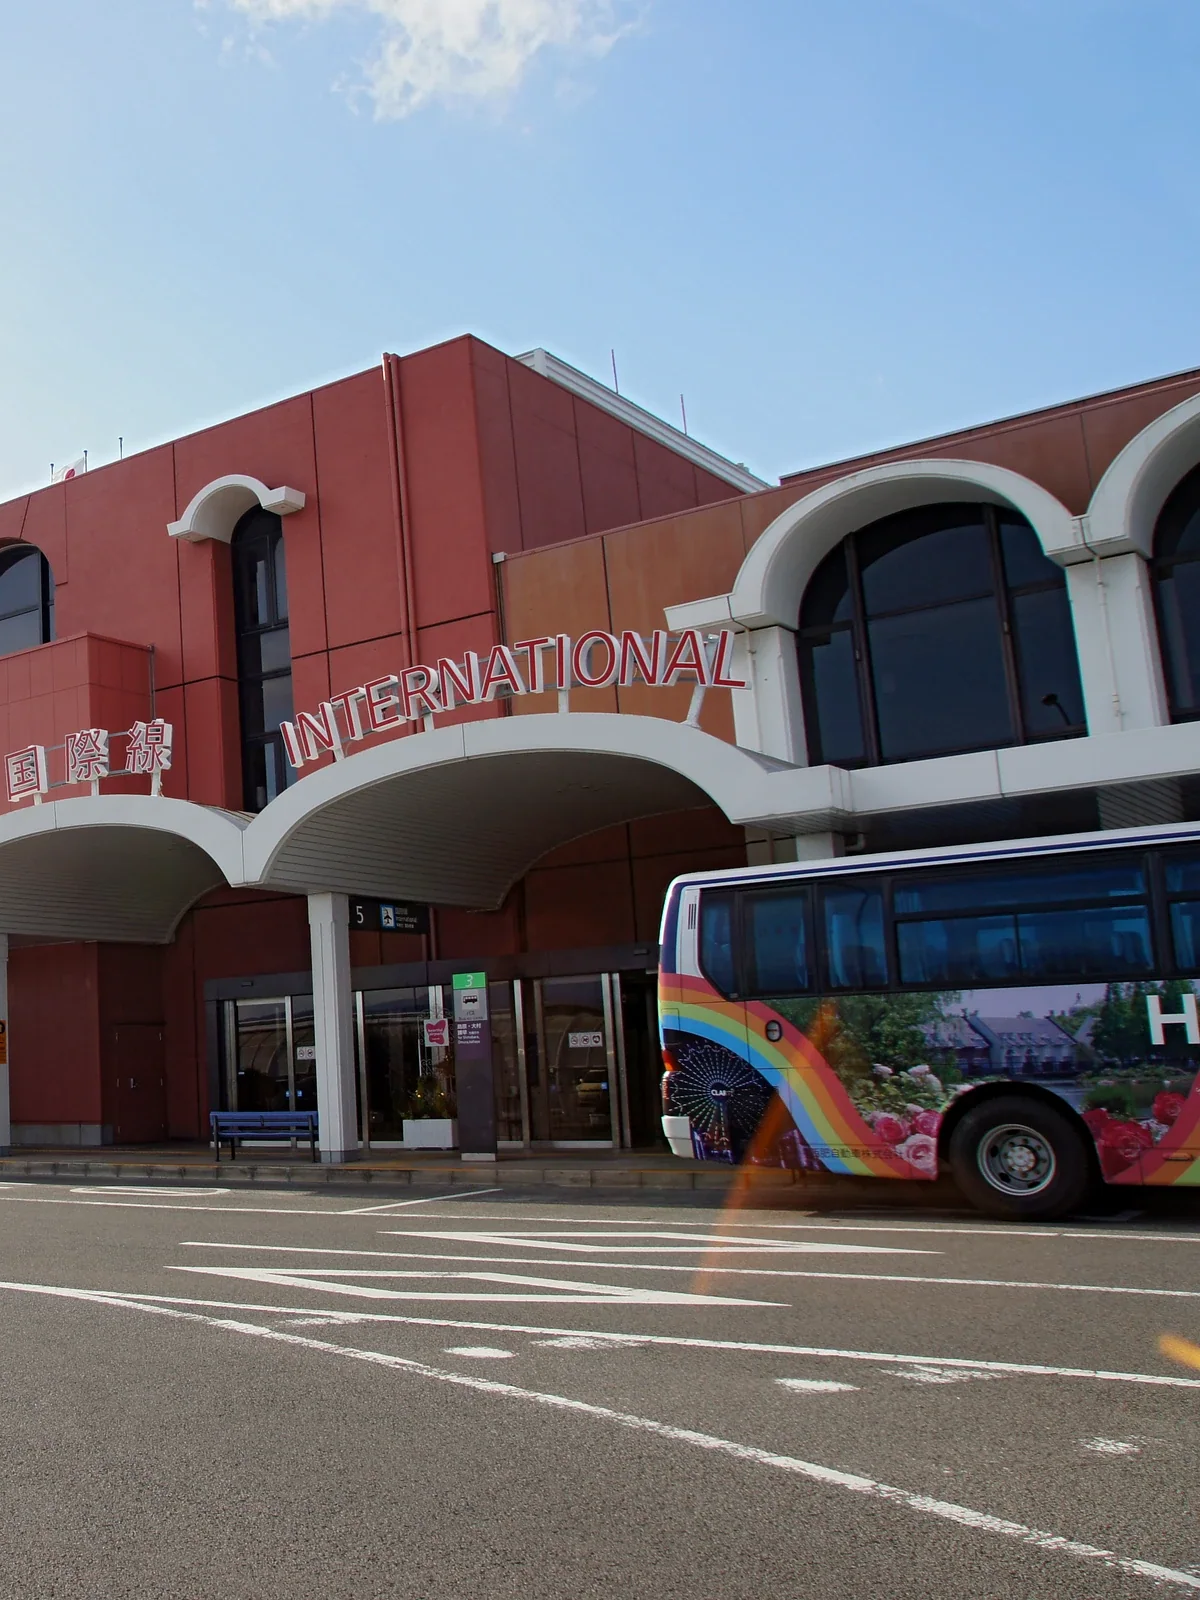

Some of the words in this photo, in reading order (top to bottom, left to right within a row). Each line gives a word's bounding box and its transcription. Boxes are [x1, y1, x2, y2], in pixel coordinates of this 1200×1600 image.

[279, 629, 752, 768] INTERNATIONAL
[4, 719, 173, 802] 国際線
[356, 905, 364, 924] 5
[465, 974, 474, 988] 3
